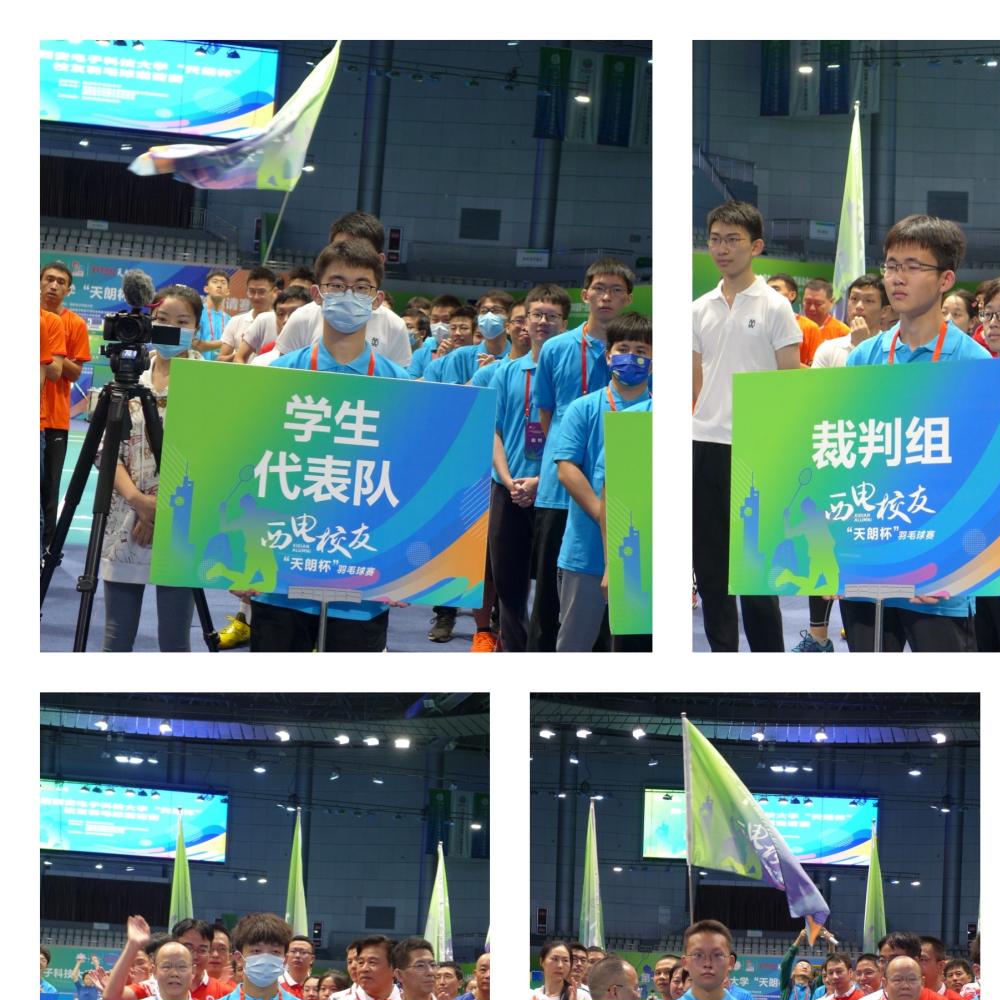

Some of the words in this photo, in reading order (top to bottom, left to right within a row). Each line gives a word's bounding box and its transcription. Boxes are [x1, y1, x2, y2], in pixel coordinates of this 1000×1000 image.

[284, 394, 380, 447] 学生
[812, 416, 952, 469] 裁判组
[253, 450, 399, 508] 代表队
[825, 481, 936, 523] 西电校友
[261, 513, 379, 559] 西电校友
